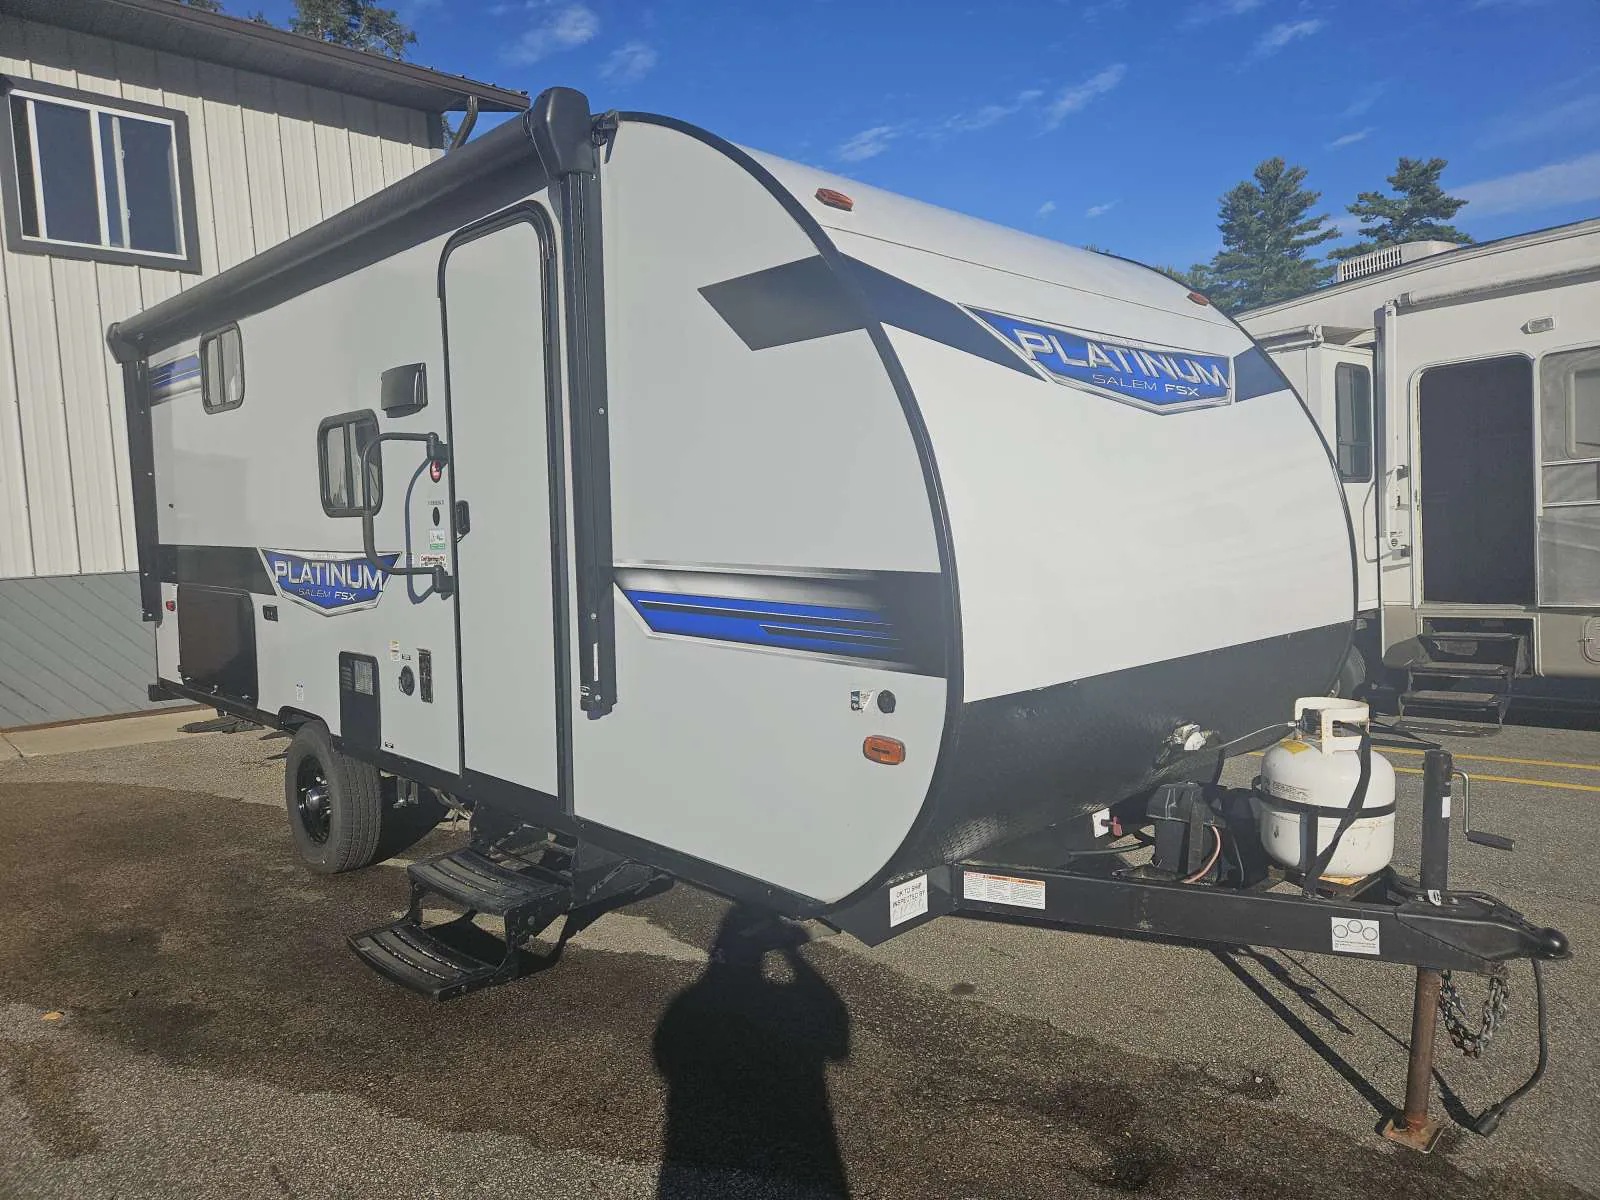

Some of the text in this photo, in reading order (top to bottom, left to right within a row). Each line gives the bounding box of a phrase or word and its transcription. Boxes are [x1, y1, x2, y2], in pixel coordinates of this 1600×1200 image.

[1013, 328, 1230, 389] PLATINUM
[1092, 374, 1200, 397] SALEM FSX
[274, 560, 384, 592] PLATINUM
[298, 588, 357, 601] SALEM FSX
